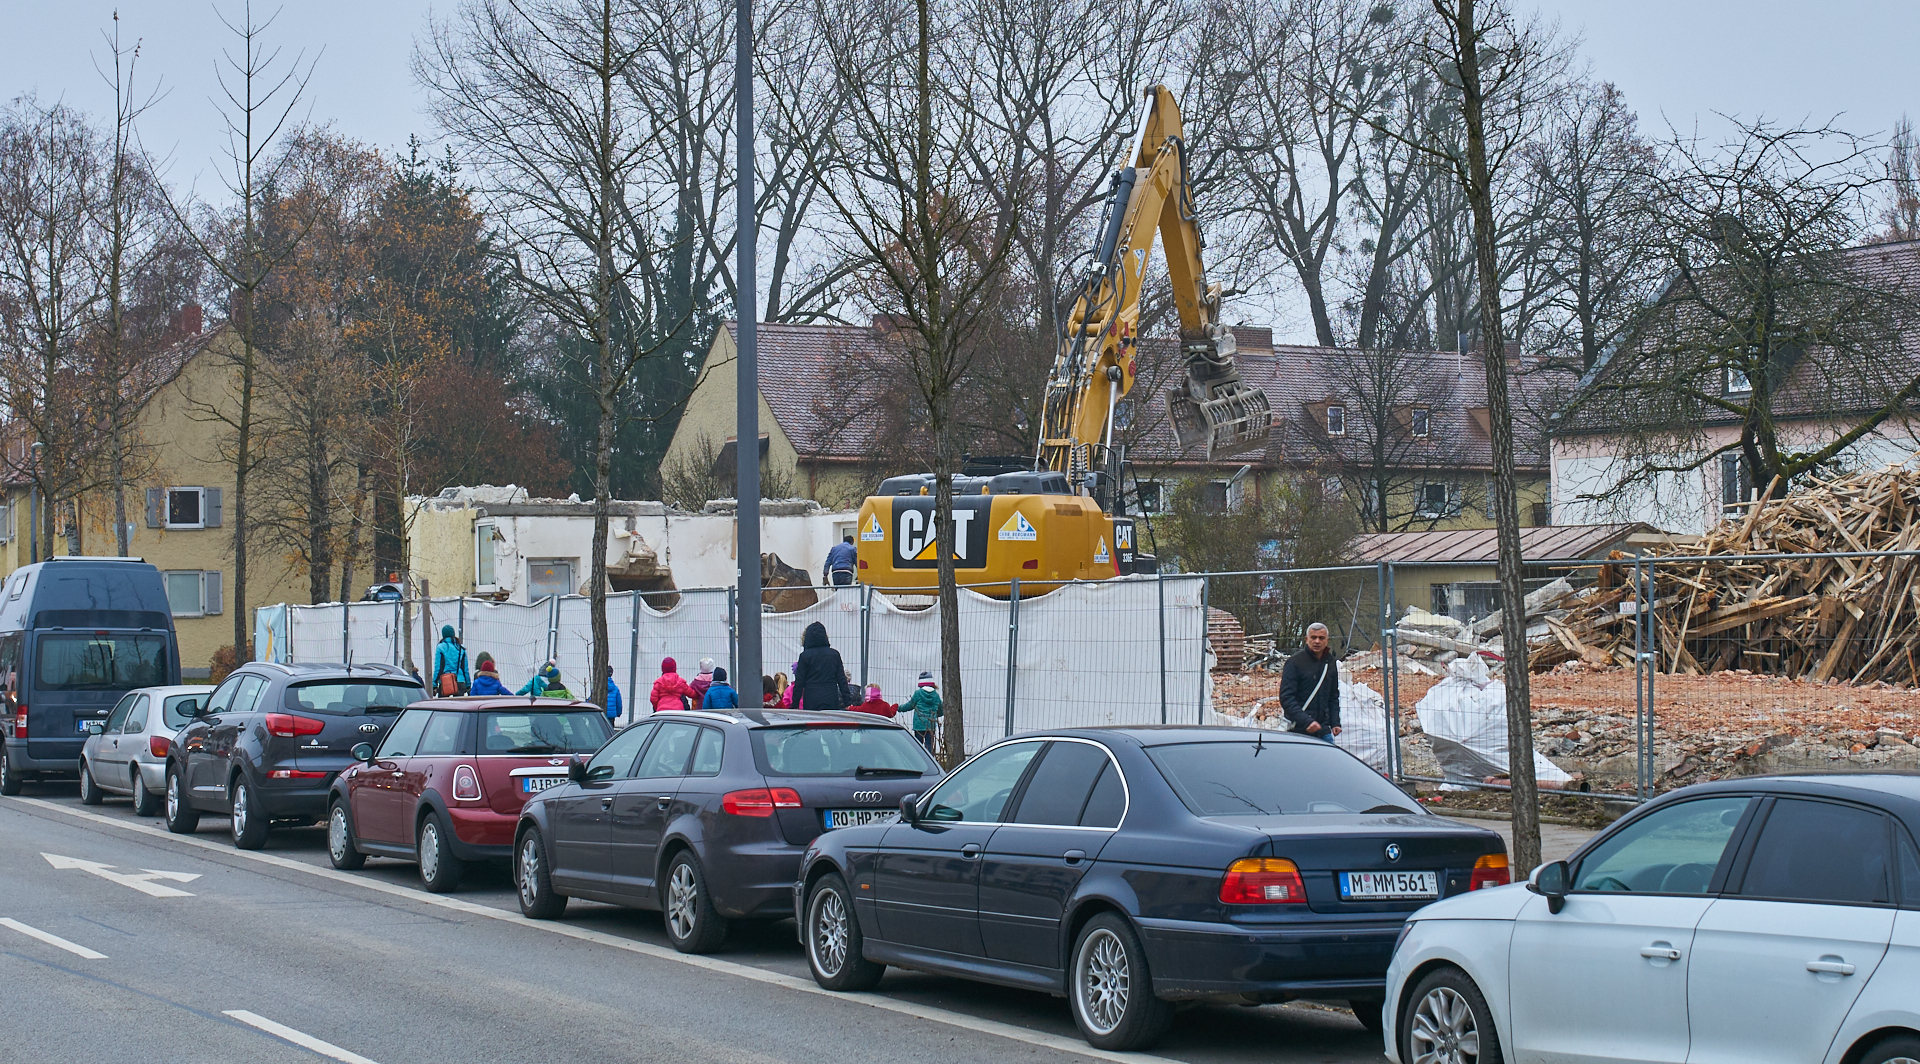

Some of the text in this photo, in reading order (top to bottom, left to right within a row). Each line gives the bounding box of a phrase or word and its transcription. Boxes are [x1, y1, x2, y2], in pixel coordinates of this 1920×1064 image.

[1115, 524, 1133, 549] CAT
[832, 811, 848, 826] RO
[1351, 873, 1428, 893] M MM 561
